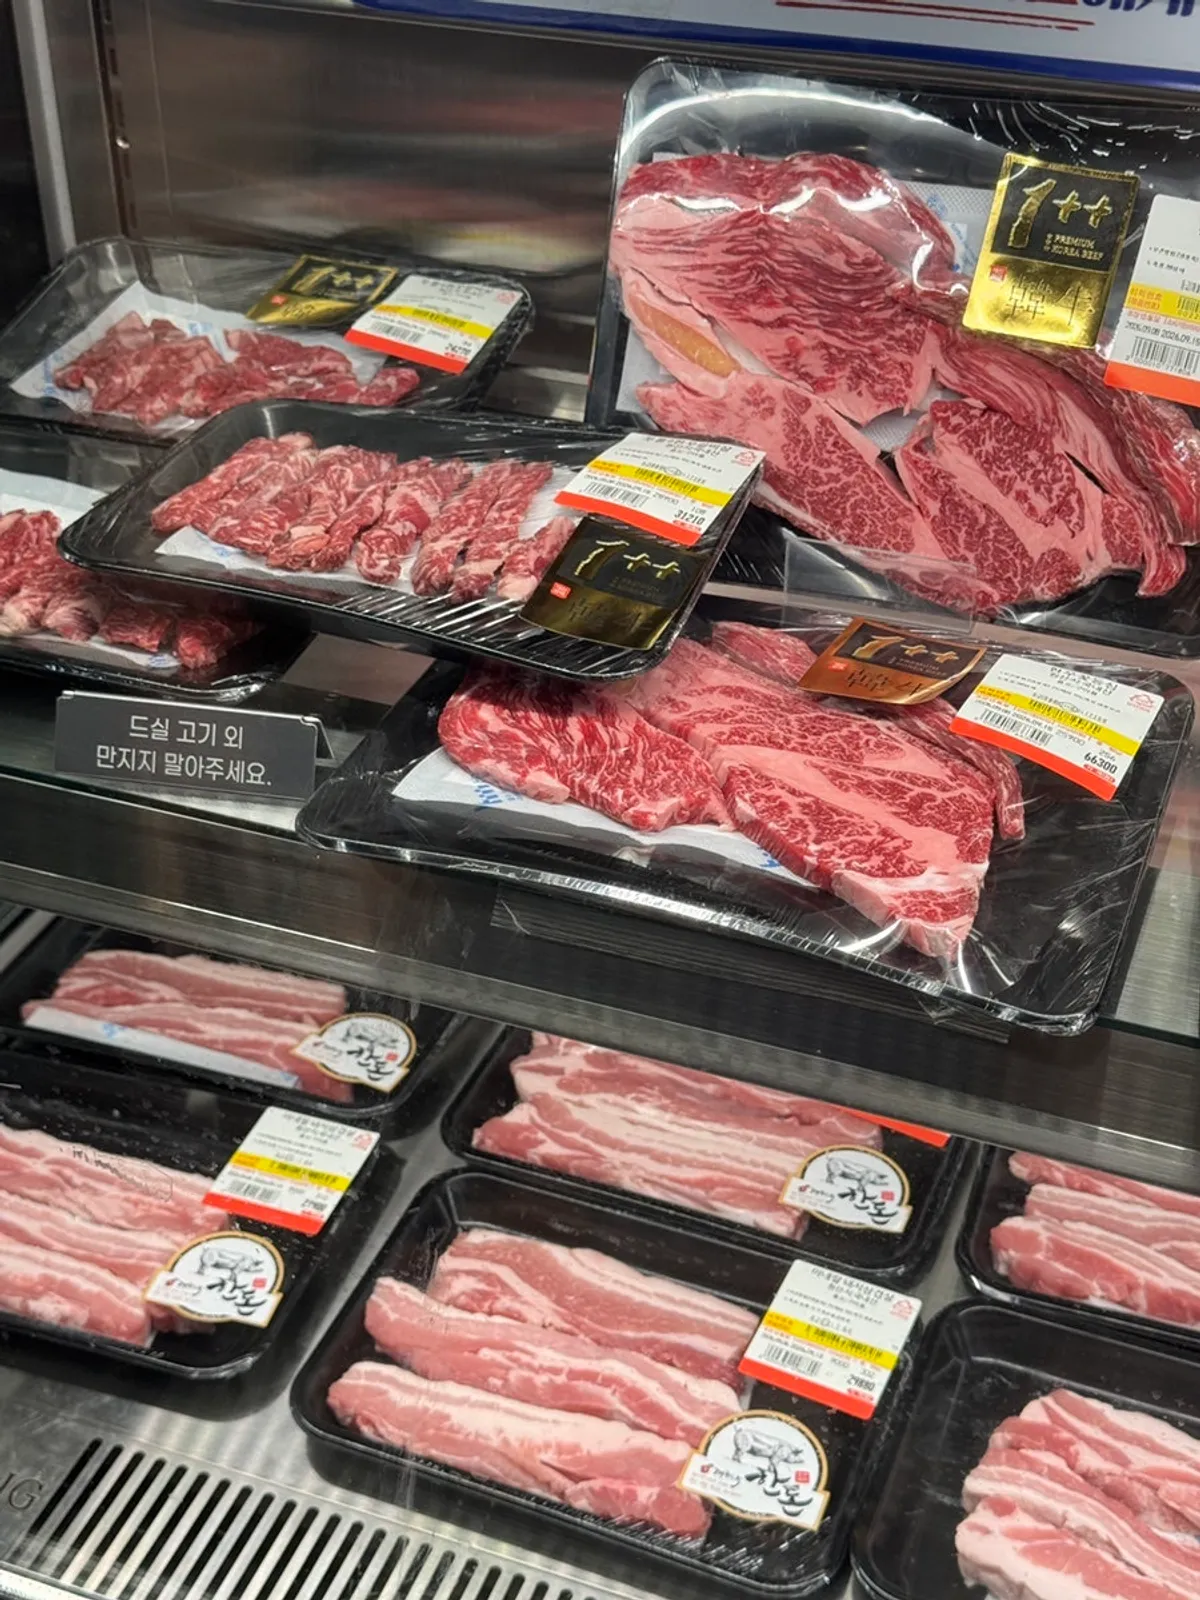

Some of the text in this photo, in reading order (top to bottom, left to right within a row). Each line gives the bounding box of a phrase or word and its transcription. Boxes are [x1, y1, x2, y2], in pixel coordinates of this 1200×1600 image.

[1008, 178, 1112, 248] 1++
[1054, 234, 1096, 249] PREMIUM
[292, 266, 374, 292] 1++
[674, 509, 706, 525] 31210
[574, 539, 682, 581] 1++
[852, 635, 960, 663] 1++
[129, 715, 244, 750] 드실 고기 외
[96, 745, 272, 786] 만지지 말아주세요.
[1084, 752, 1118, 774] 66300
